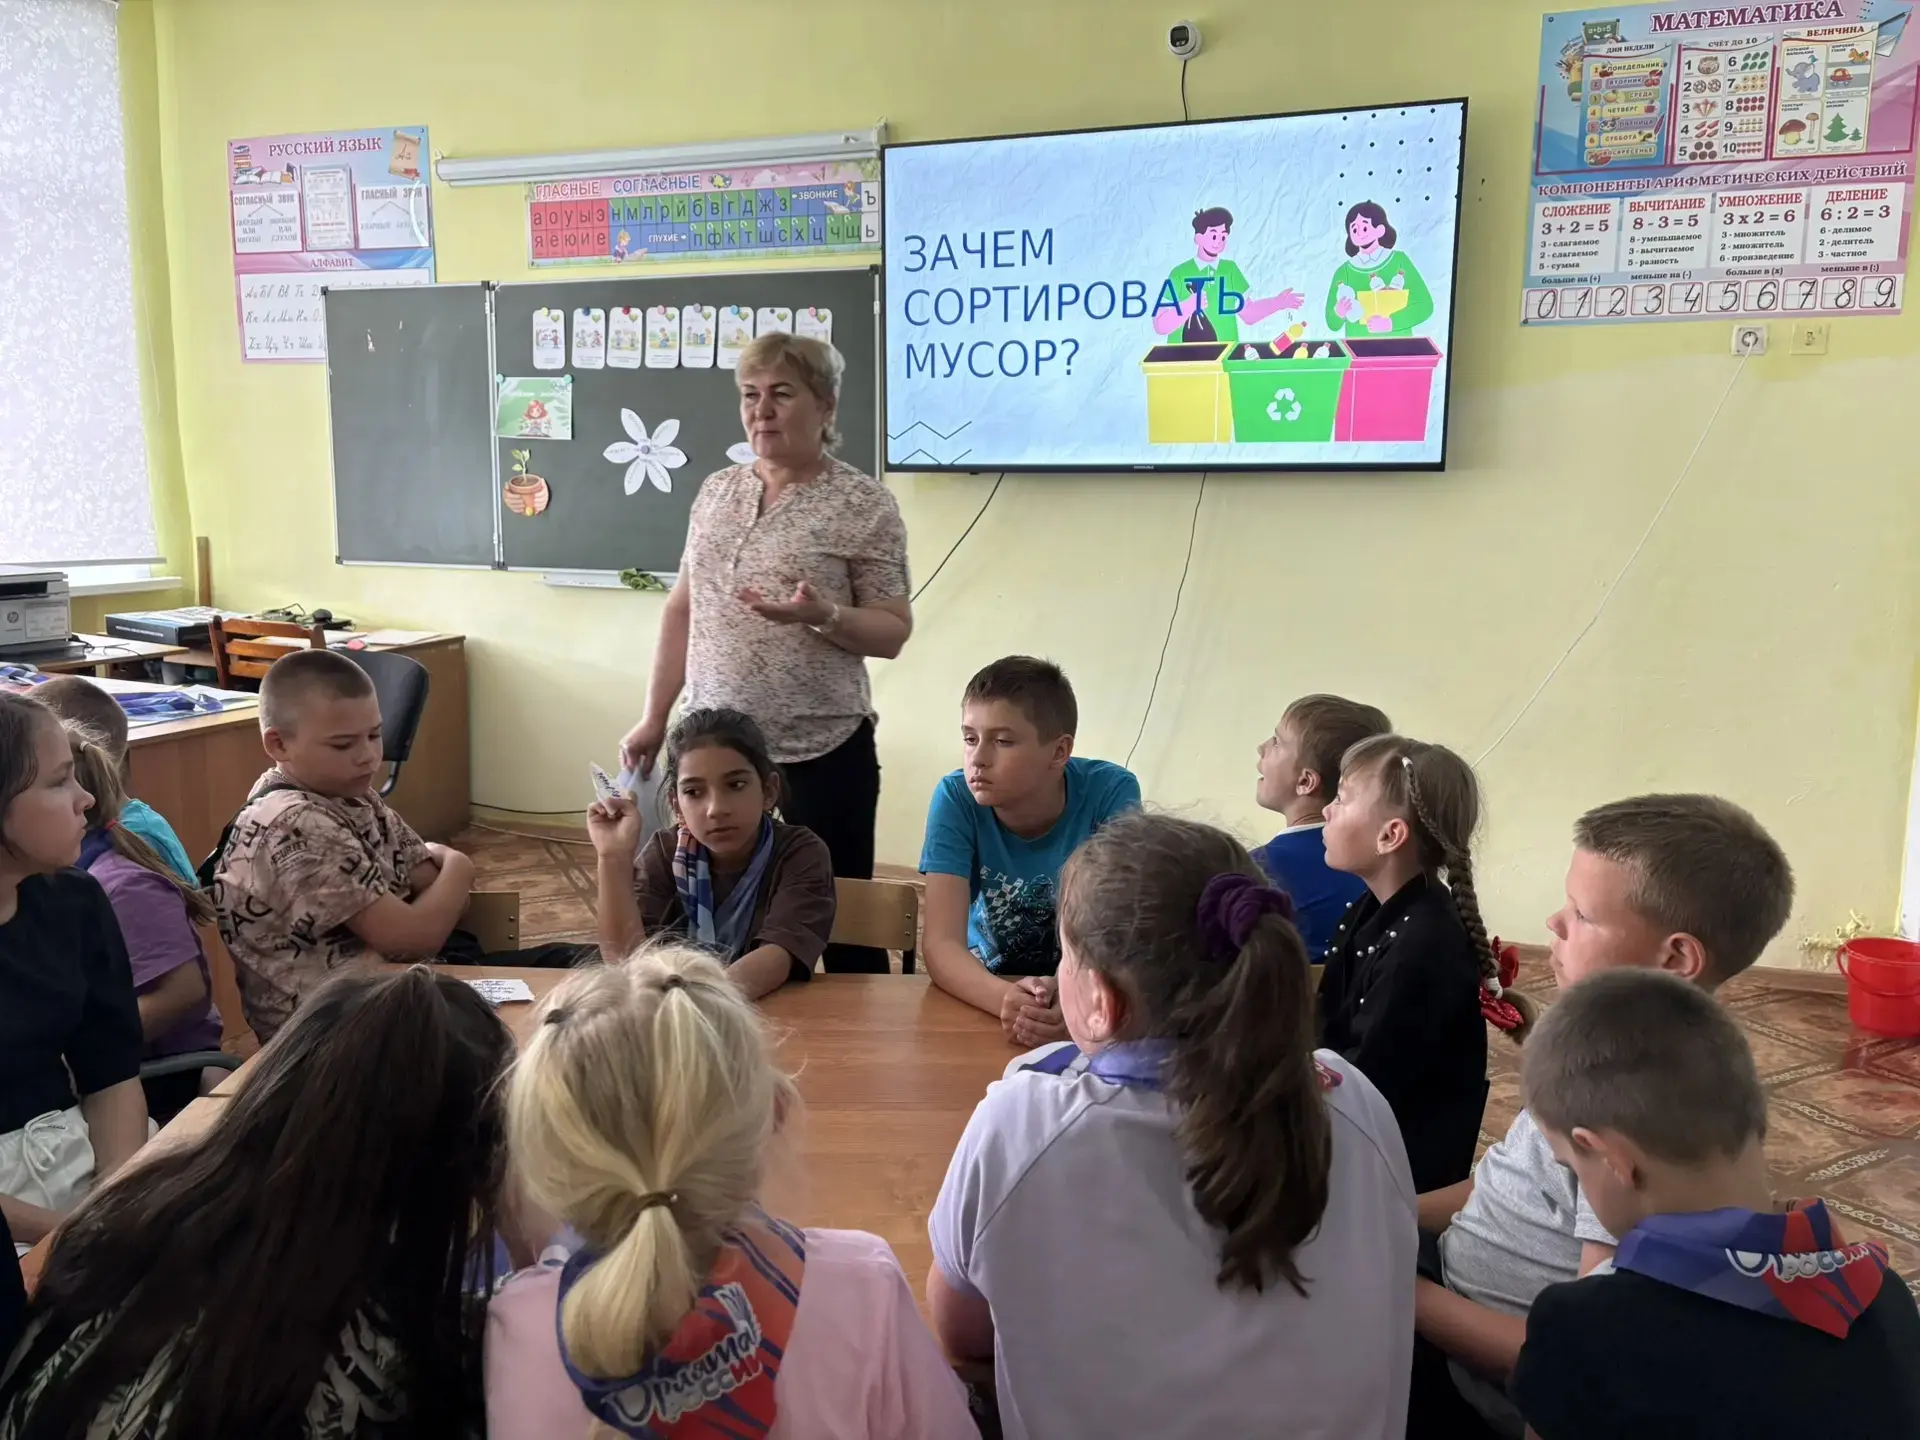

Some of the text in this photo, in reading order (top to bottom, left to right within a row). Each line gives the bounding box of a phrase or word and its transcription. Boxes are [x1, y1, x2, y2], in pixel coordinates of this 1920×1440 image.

[1651, 1, 1844, 32] МАТЕМАТИКА
[1807, 26, 1864, 36] ВЕЛИЧИНА
[1685, 60, 1691, 70] 1
[1729, 57, 1736, 66] 6
[1608, 63, 1659, 71] ПОНЕДЕЛЬНИК
[1684, 82, 1691, 92] 2
[1728, 79, 1735, 88] 7
[1682, 104, 1690, 113] 3
[1726, 101, 1733, 110] 8
[1681, 125, 1689, 134] 4
[1725, 122, 1733, 131] 9
[269, 138, 334, 156] РУССКИЙ
[339, 137, 382, 152] ЯЗЫК
[1723, 143, 1736, 152] 10
[1679, 147, 1687, 156] 5
[1539, 162, 1905, 195] КОМПОНЕНТЫ АРИФМЕТИЧЕСКИХ ДЕЙСТВИЙ
[536, 175, 700, 198] ГЛАСНЫЕ СОГЛАСНЫЕ
[362, 187, 397, 200] ГЛАСНЫЙ
[798, 190, 838, 200] ЗВОНКИЕ
[1825, 189, 1888, 205] ДЕЛЕНИЕ
[235, 193, 273, 205] СОГЛАСНЫЙ
[1719, 193, 1802, 207] УМНОЖЕНИЕ
[1629, 198, 1705, 212] ВЫЧИТАНИЕ
[1542, 203, 1611, 218] СЛОЖЕНИЕ
[1821, 205, 1890, 220] 6 2 3
[1633, 215, 1698, 229] 8 3 5
[1723, 210, 1795, 225] 3 2 6
[1542, 219, 1609, 235] 3 2 5
[1831, 226, 1872, 234] делимое
[648, 234, 679, 243] ГЛУХИЕ
[1642, 234, 1702, 243] уменьшаемое
[1734, 230, 1785, 238] множитель
[1553, 239, 1599, 247] слагаемое
[1732, 242, 1784, 250] множитель
[1831, 238, 1874, 246] делитель
[903, 228, 1055, 272] ЗАЧЕМ
[1552, 250, 1598, 258] слагаемое
[1641, 246, 1694, 254] вычитаемое
[1831, 250, 1867, 258] частное
[1732, 253, 1794, 262] произведение
[311, 258, 353, 267] АЛФАВИТ
[1552, 262, 1580, 270] сумма
[1640, 258, 1679, 267] разность
[1590, 275, 1601, 283] (+)
[904, 276, 1246, 326] СОРТИРОВАТЬ
[1538, 278, 1893, 318] 0 1 2 3 4 5 6 7 8 9
[905, 339, 1080, 379] МУСОР?
